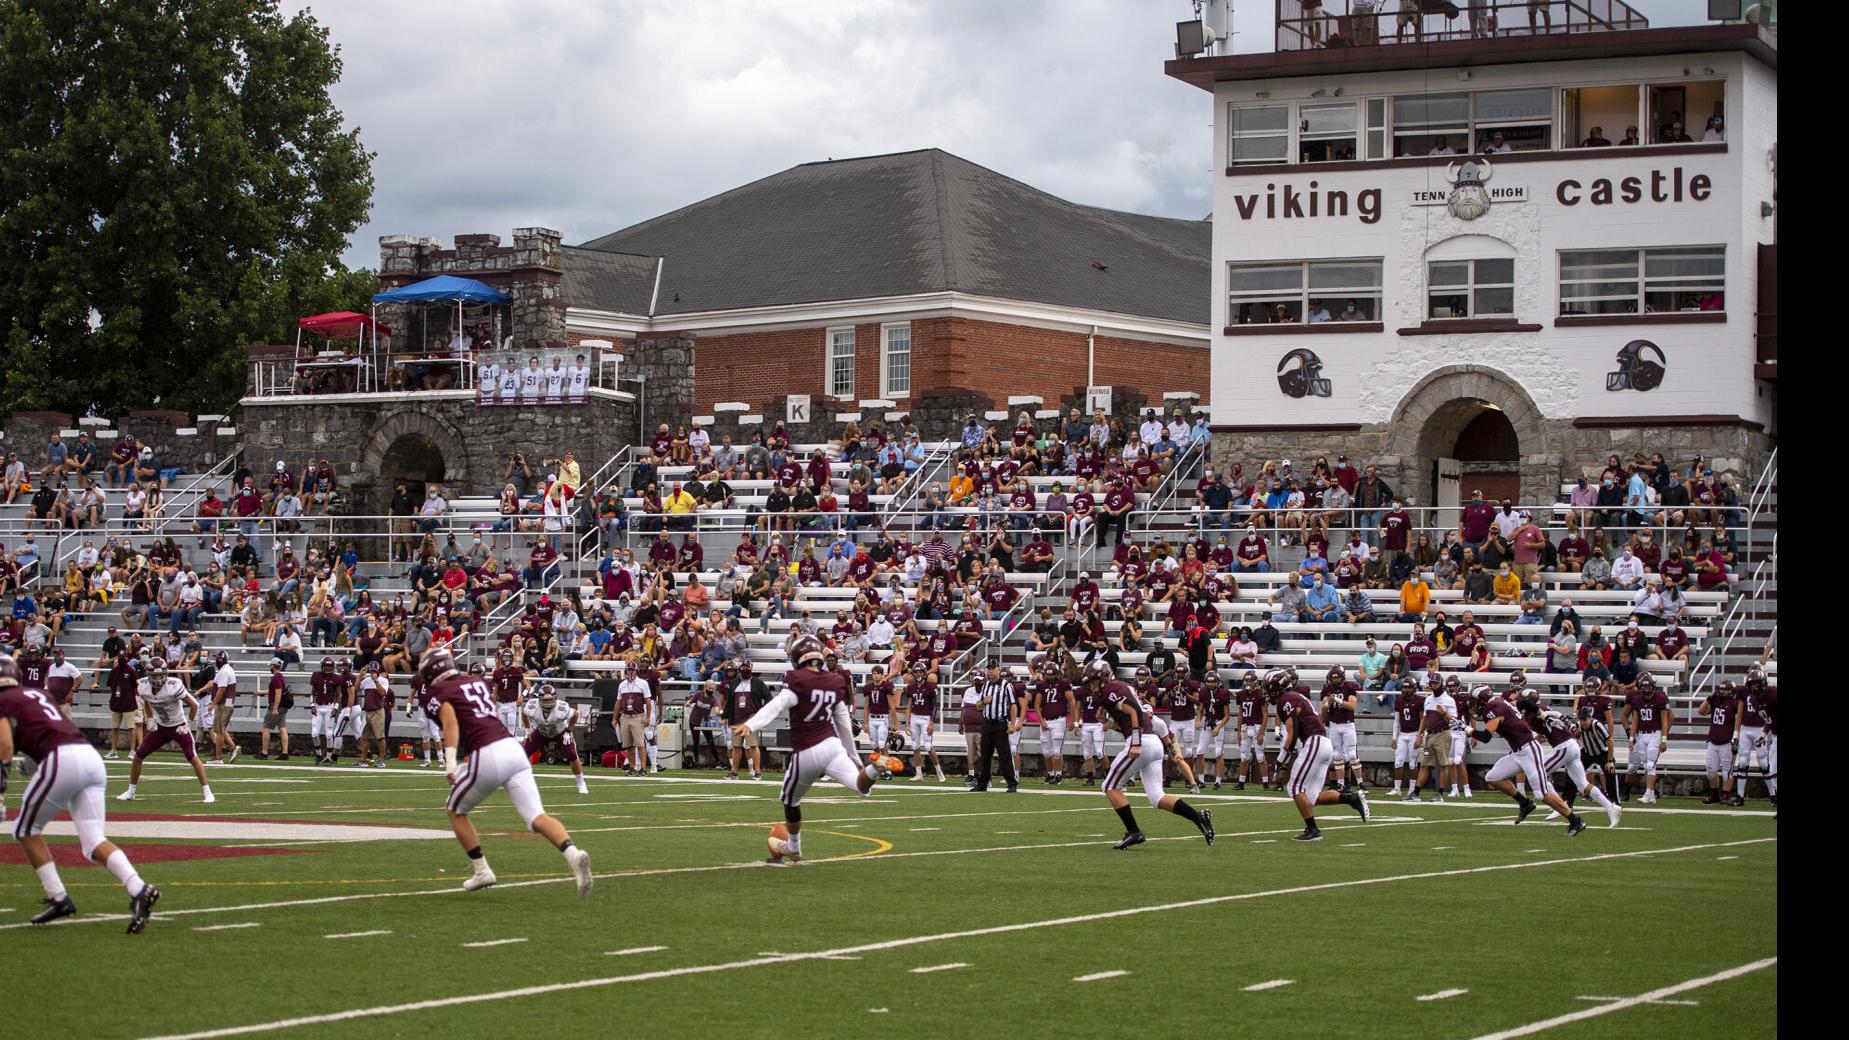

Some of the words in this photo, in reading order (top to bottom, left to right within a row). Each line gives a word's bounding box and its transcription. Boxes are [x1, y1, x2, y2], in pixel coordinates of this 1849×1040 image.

[1234, 181, 1382, 225] viking
[1556, 167, 1712, 206] castle
[1413, 191, 1446, 201] TENN
[1491, 187, 1523, 198] HIGH
[1092, 396, 1106, 411] L
[792, 404, 804, 420] K
[27, 667, 39, 681] 76
[501, 678, 508, 690] 7
[460, 680, 499, 719] 53
[1045, 688, 1058, 703] 72
[1086, 696, 1094, 709] 2
[23, 690, 62, 721] 3
[1242, 701, 1253, 717] 57
[1713, 707, 1727, 725] 65
